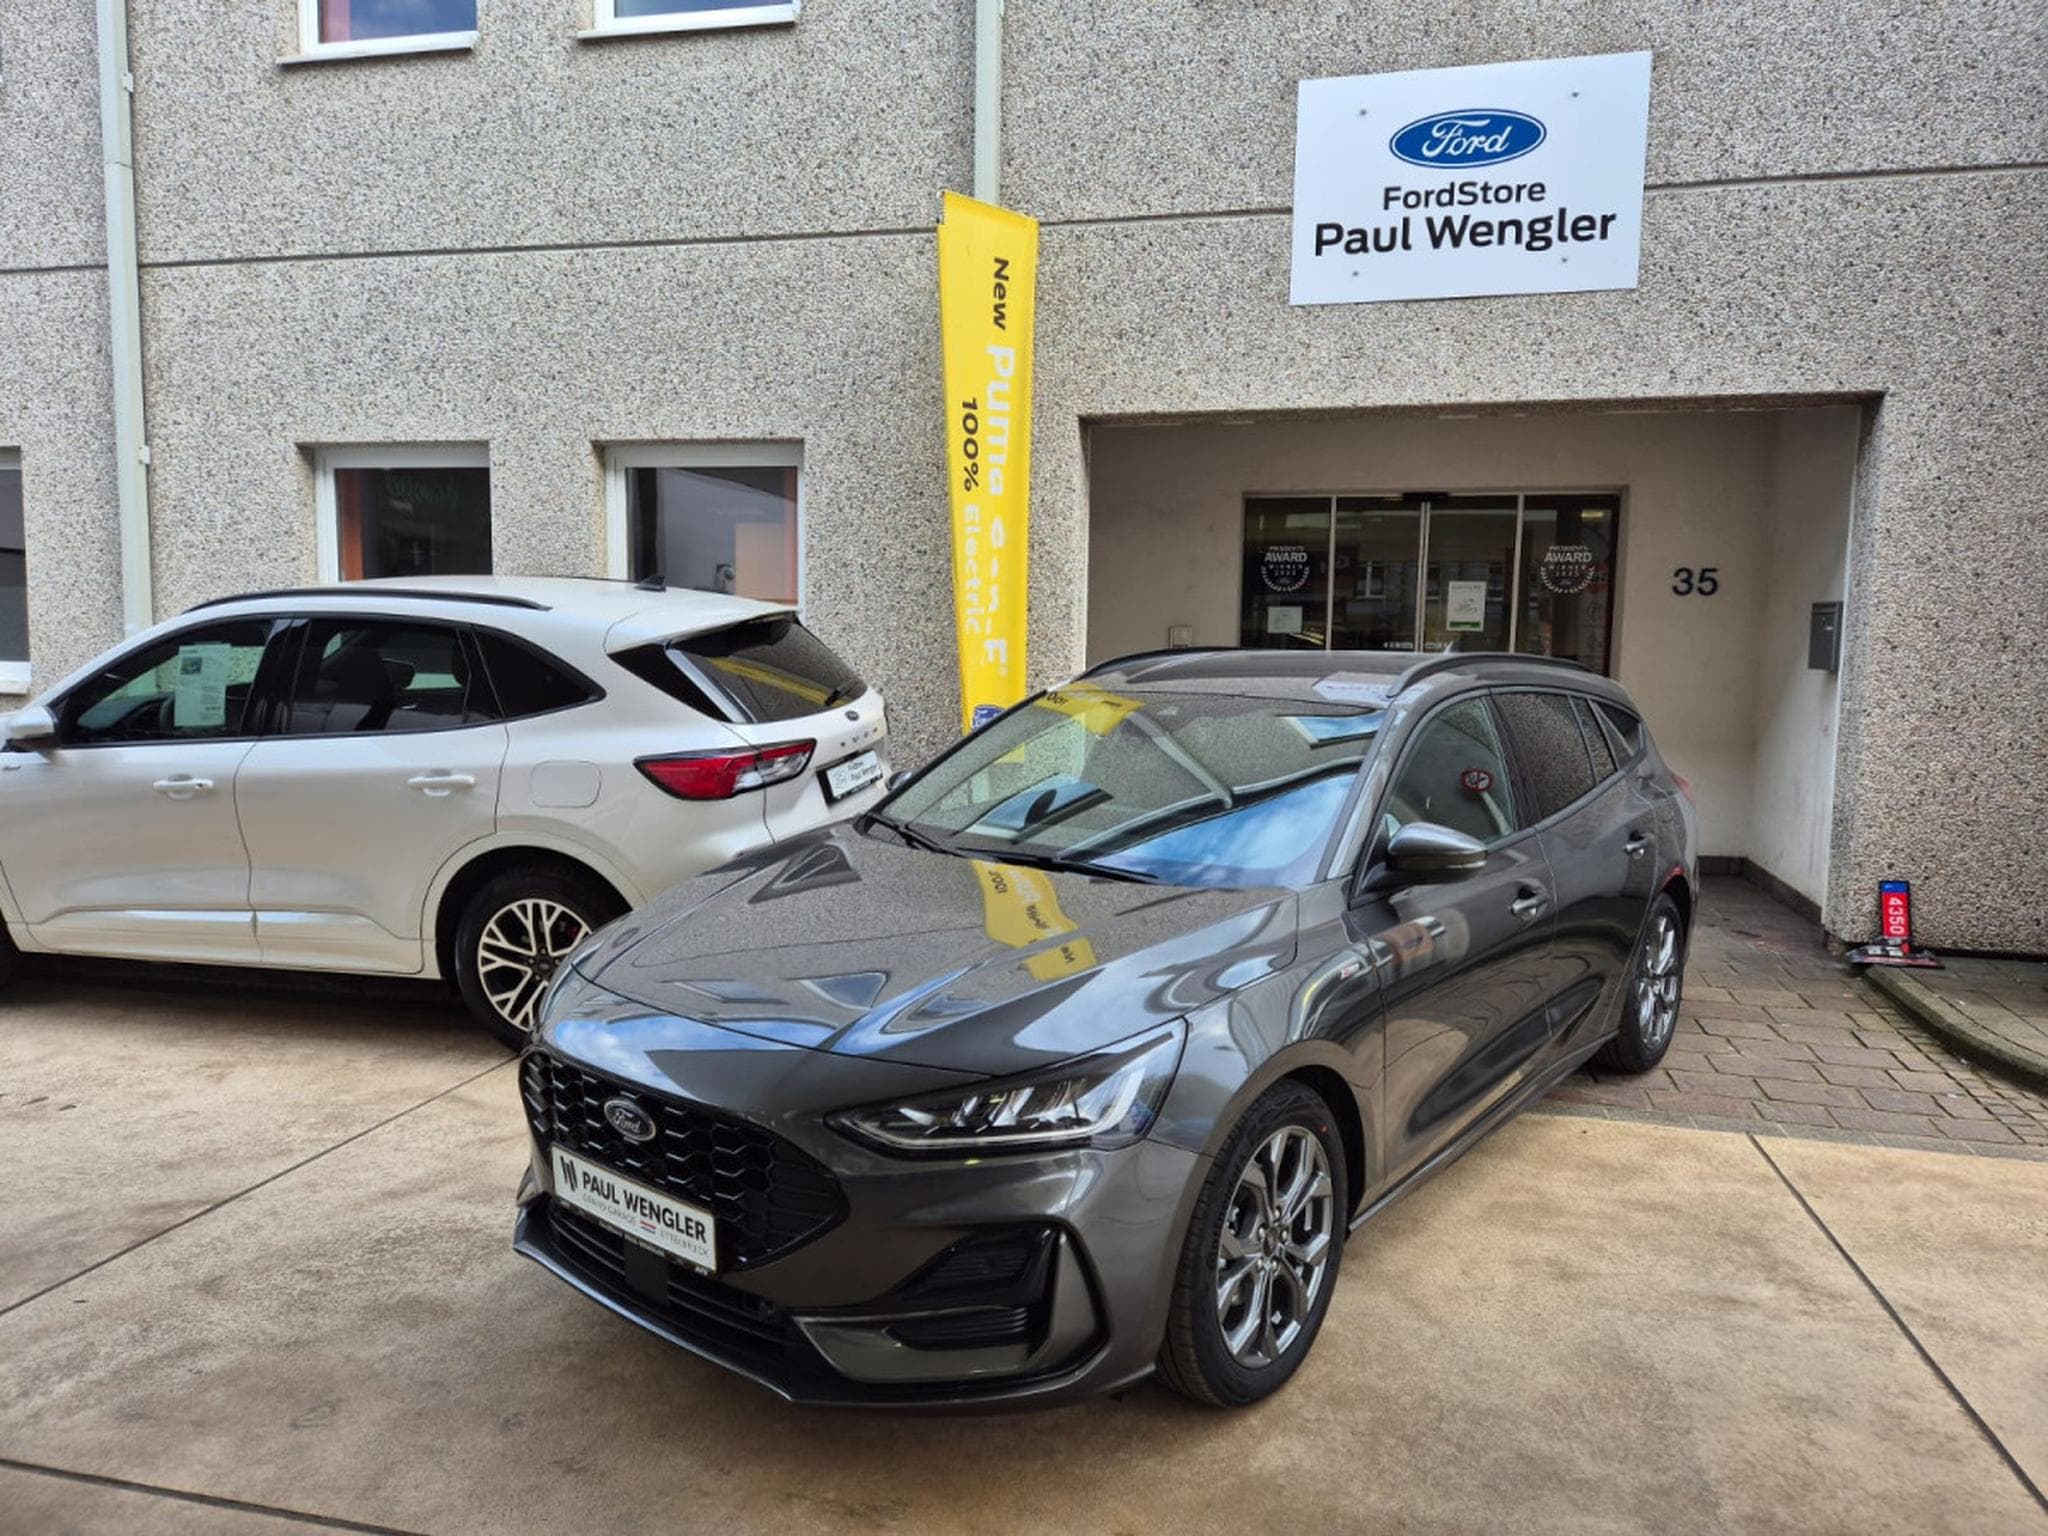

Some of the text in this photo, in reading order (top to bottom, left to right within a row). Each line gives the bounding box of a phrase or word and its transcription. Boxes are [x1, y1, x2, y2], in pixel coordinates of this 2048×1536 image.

[1422, 119, 1511, 158] Ford
[1383, 180, 1546, 210] FordStore
[1314, 207, 1617, 256] Paul Wengler
[993, 257, 1010, 330] New
[962, 397, 979, 492] 100%
[1264, 552, 1308, 562] AWARD
[1544, 552, 1592, 562] AWARD
[1672, 567, 1719, 596] 35
[1889, 898, 1904, 934] 4350
[582, 1171, 620, 1205] PAUL
[623, 1188, 707, 1244] WENGLER
